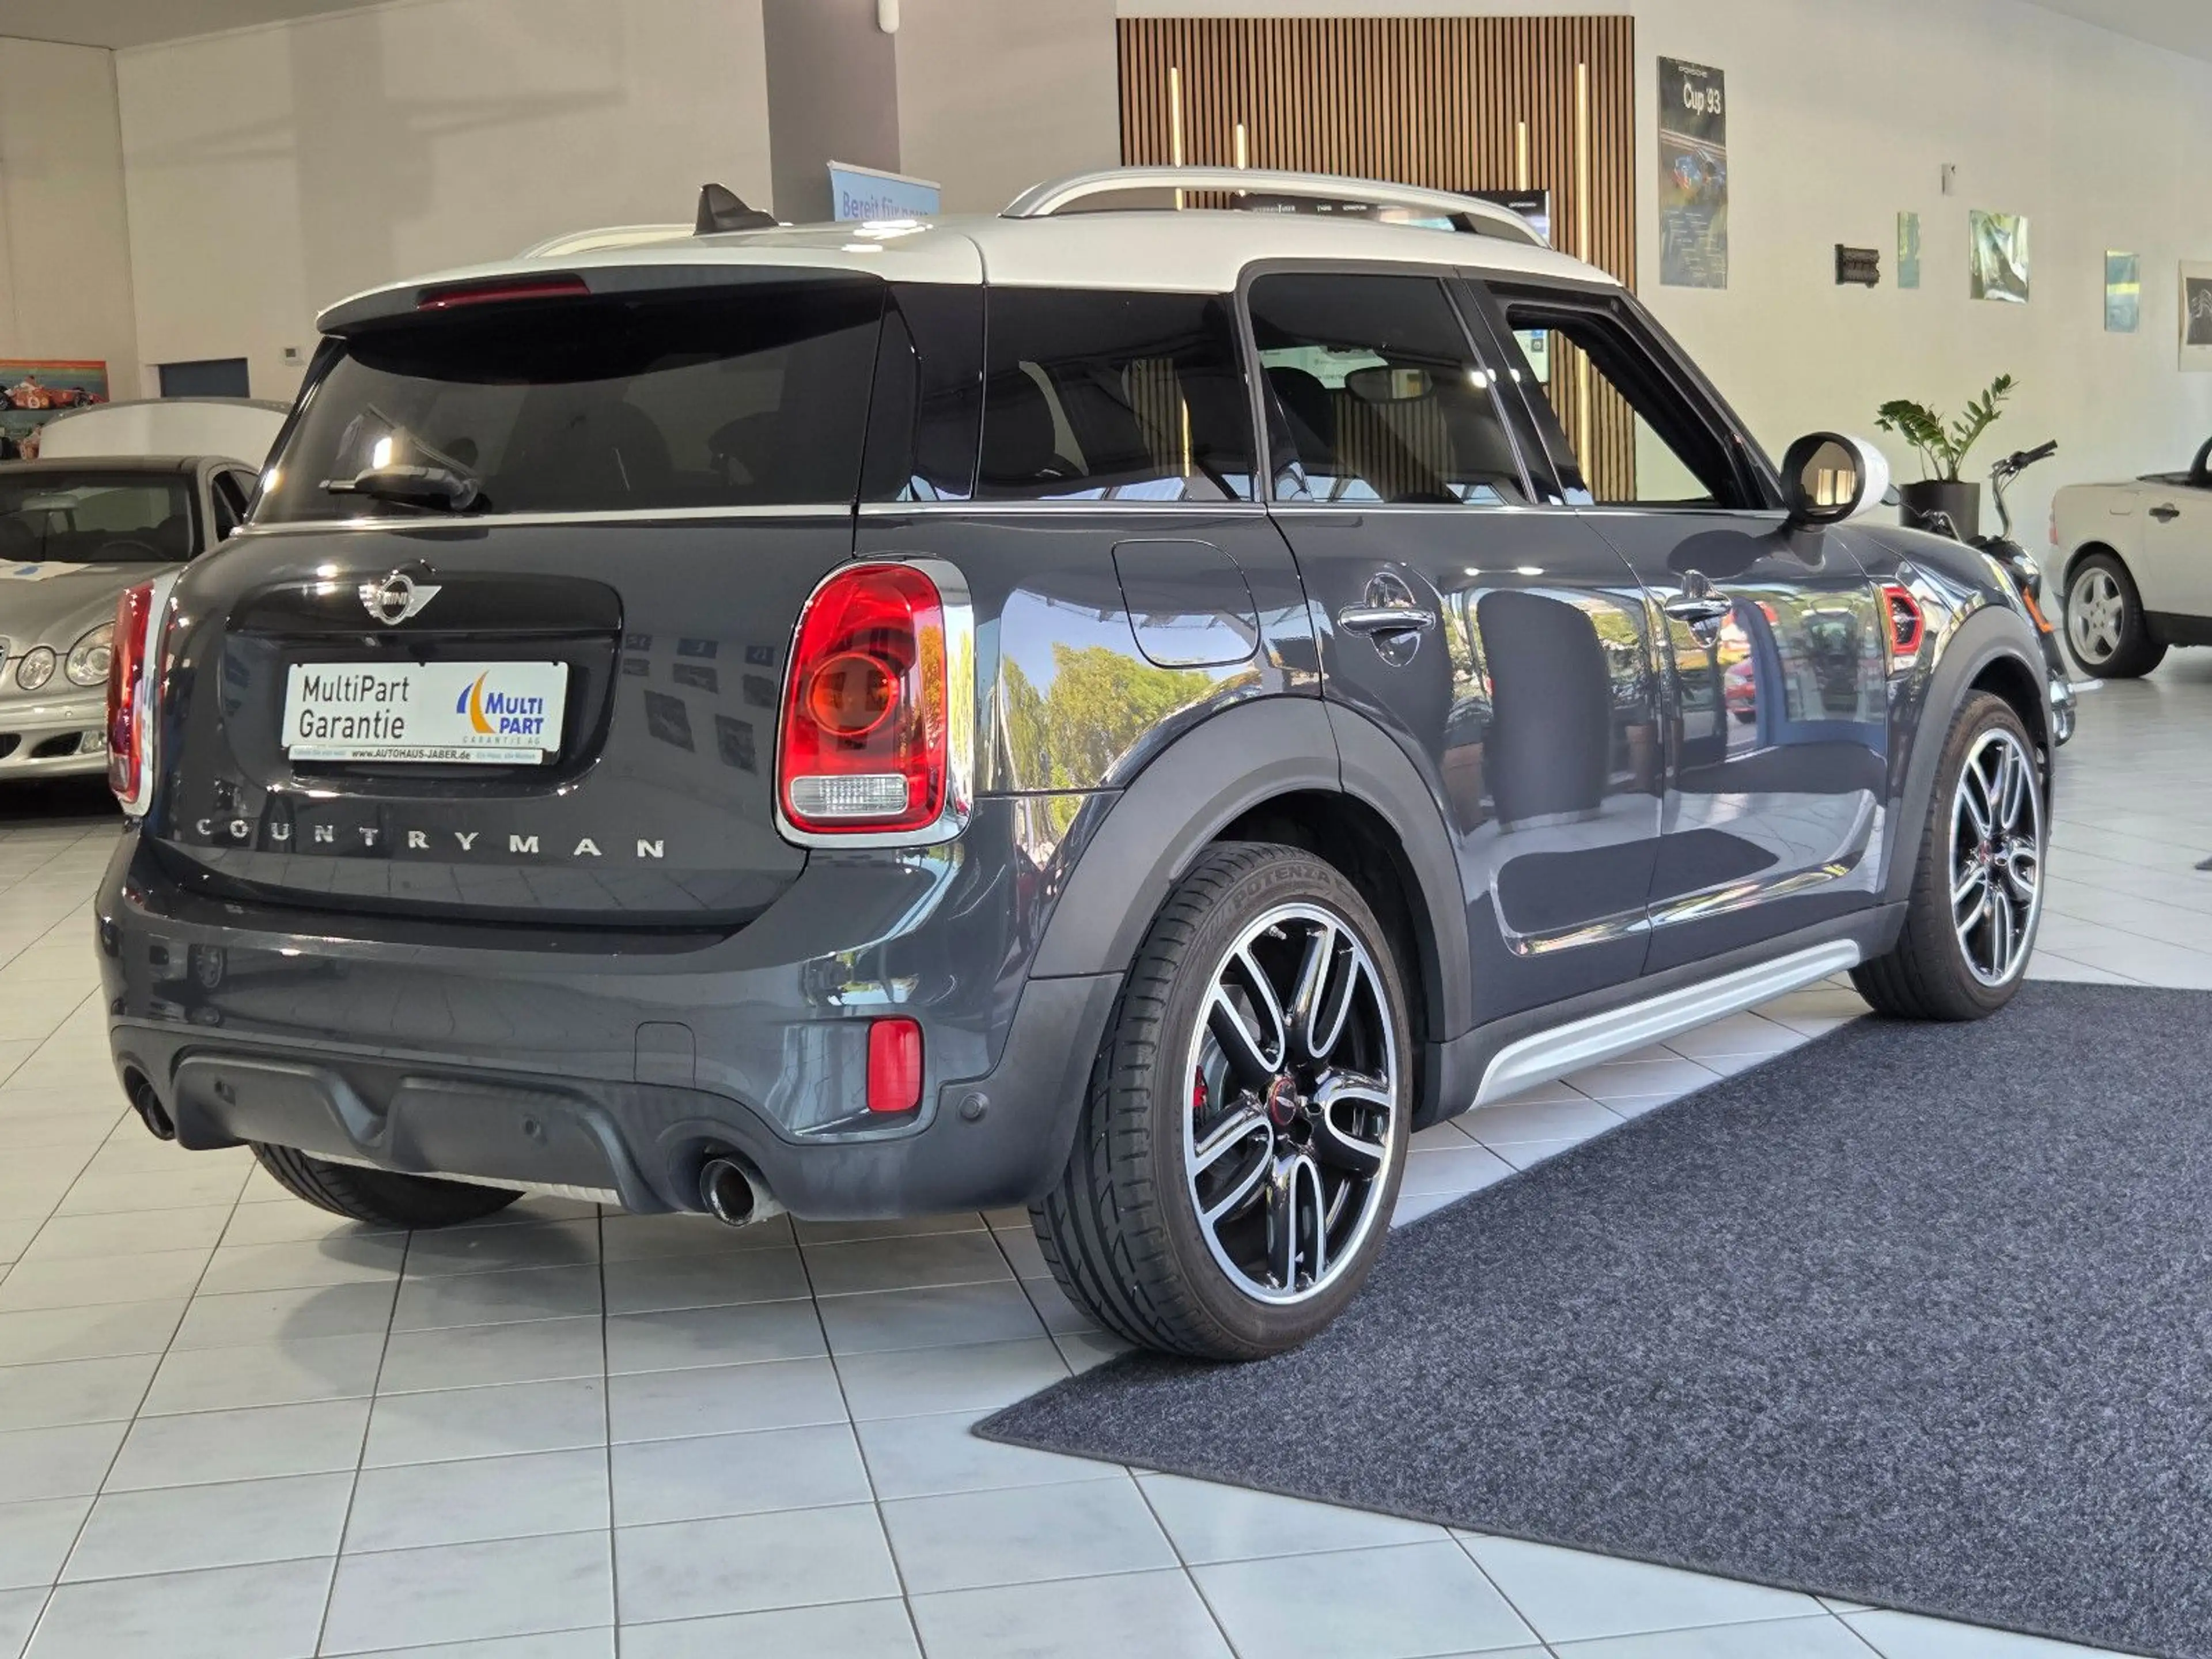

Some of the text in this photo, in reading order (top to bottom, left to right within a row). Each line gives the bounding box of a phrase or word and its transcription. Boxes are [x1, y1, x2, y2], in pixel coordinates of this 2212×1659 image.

[1684, 83, 1705, 115] Cup
[843, 191, 878, 218] Bereit
[302, 675, 410, 702] MultiPart
[299, 709, 404, 738] Garantie
[499, 717, 544, 734] PART
[352, 748, 471, 760] www.AUTOHAUS-JABER.de
[528, 737, 540, 745] AG
[195, 818, 664, 858] COUNTRYMAN
[1233, 865, 1331, 909] POTENZA
